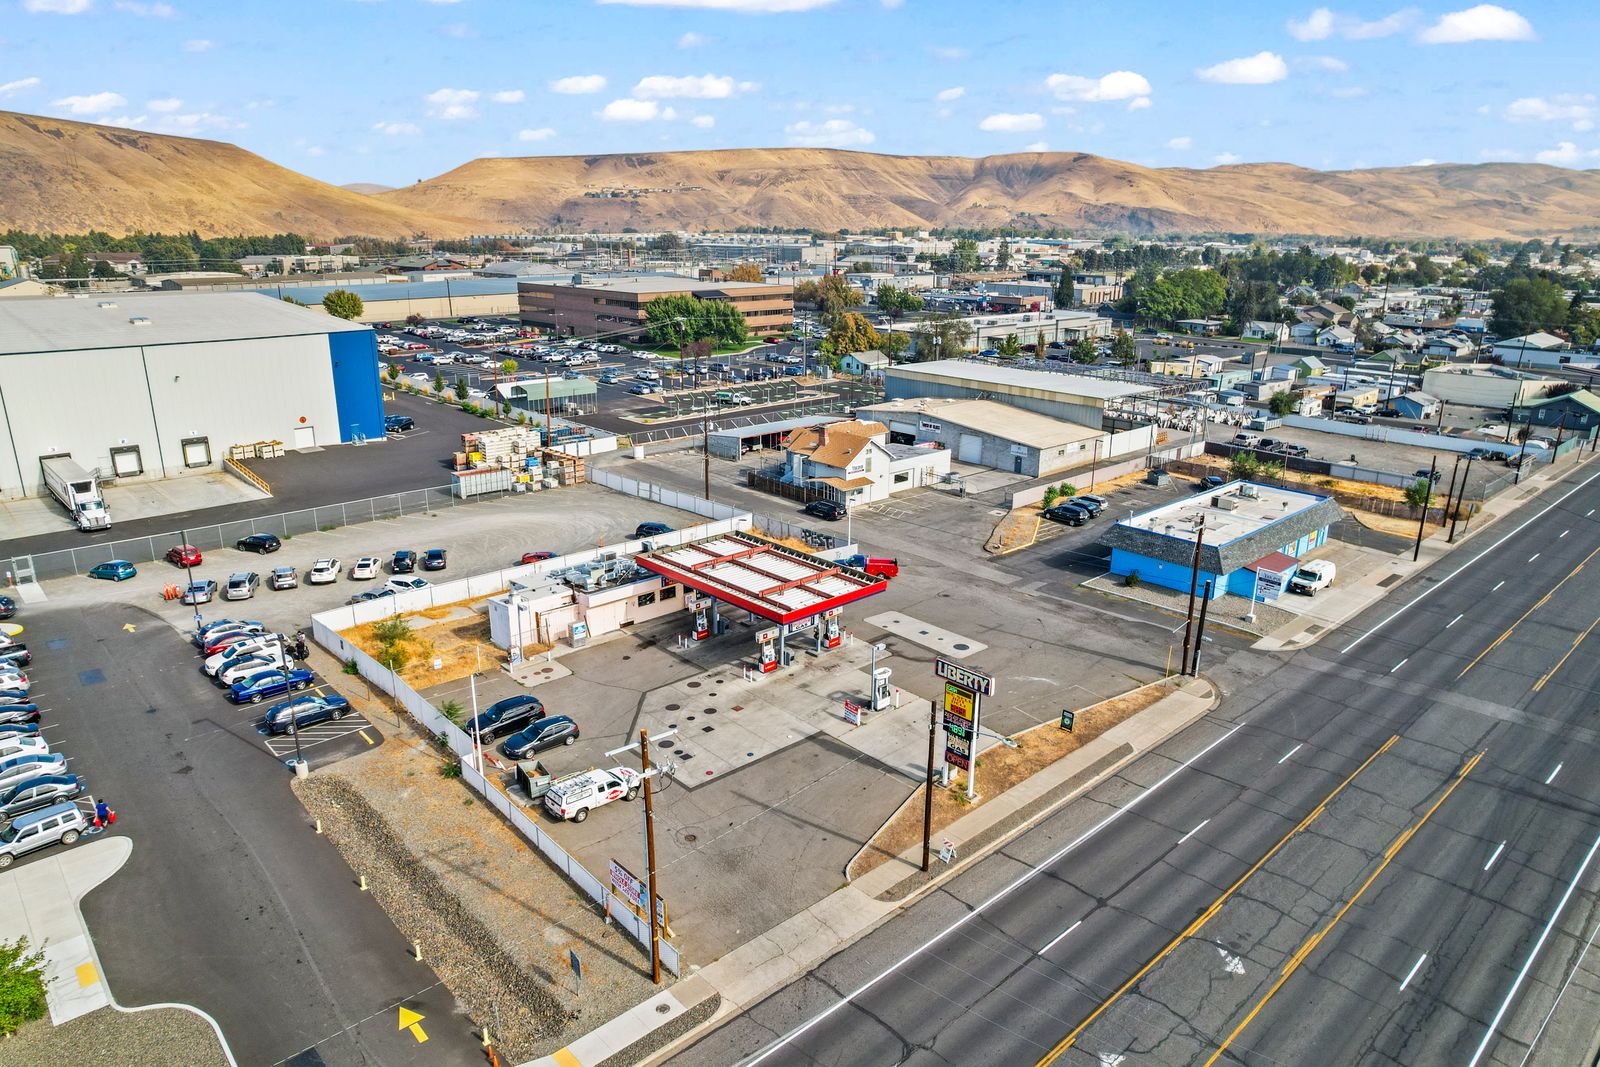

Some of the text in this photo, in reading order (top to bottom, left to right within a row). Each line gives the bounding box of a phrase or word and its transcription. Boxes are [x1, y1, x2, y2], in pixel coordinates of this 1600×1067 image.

[937, 661, 988, 692] LIBERTY
[950, 743, 966, 753] GAS
[946, 754, 969, 769] OPEN
